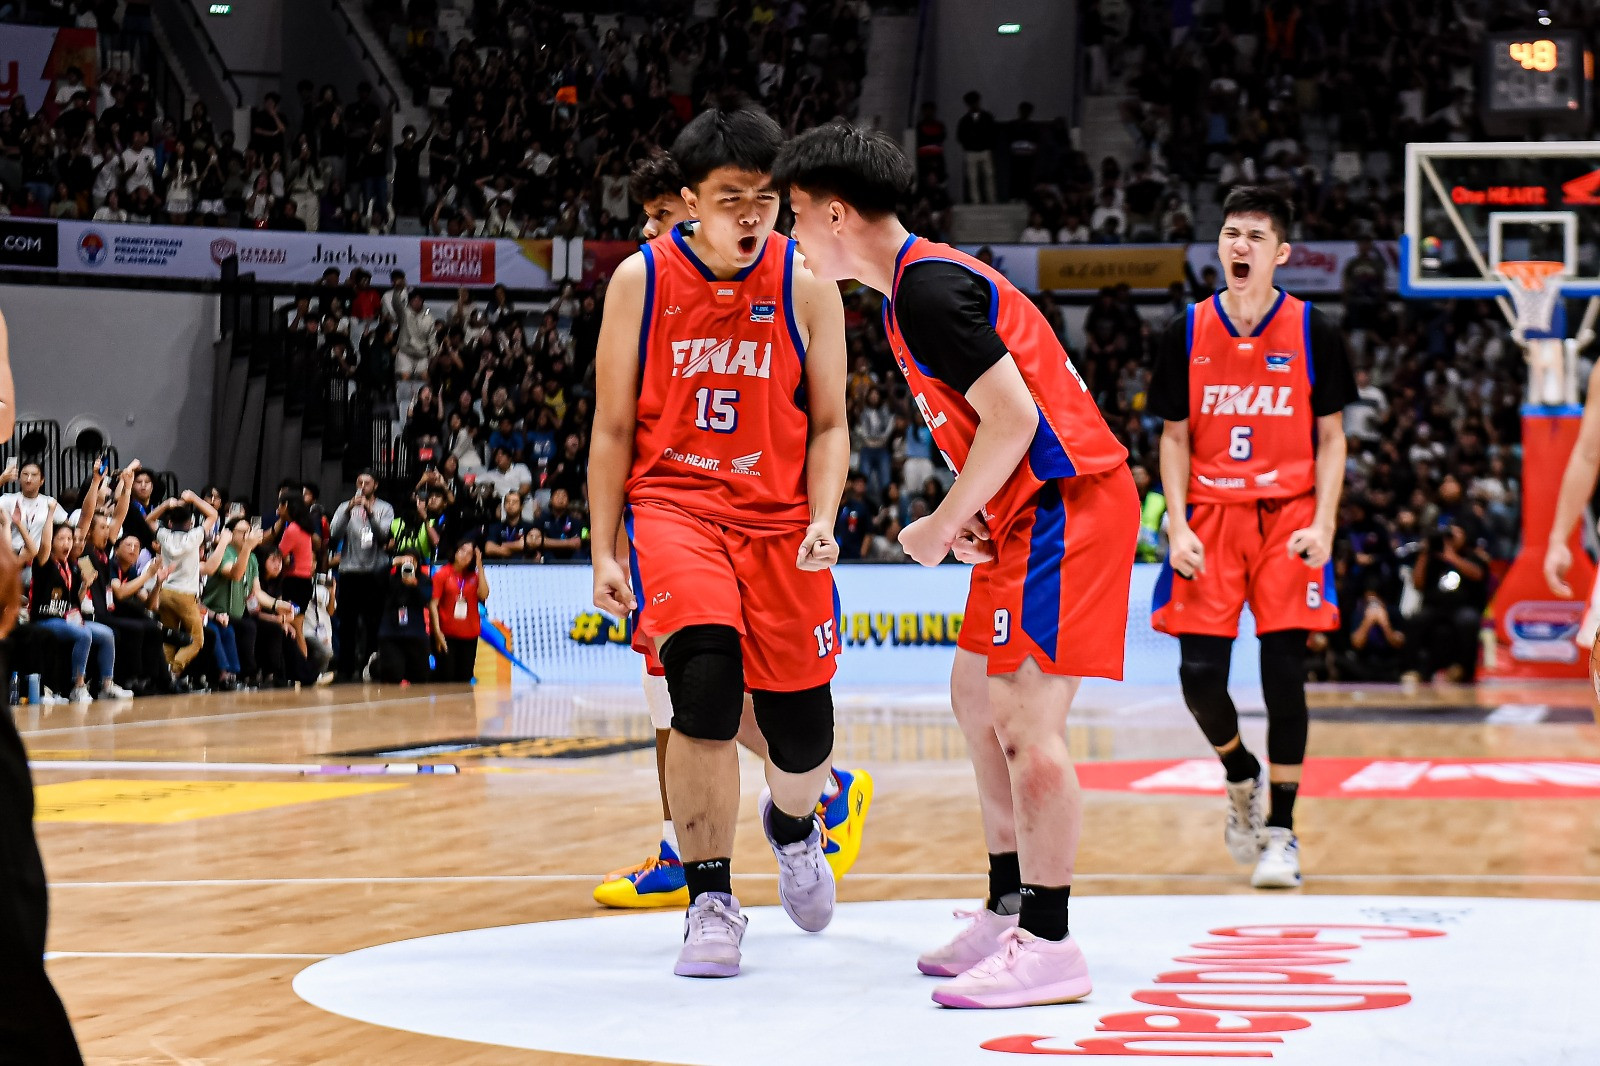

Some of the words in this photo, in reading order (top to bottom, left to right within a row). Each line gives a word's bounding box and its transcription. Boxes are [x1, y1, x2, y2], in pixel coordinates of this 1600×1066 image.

[1509, 39, 1557, 72] 48
[312, 243, 398, 266] Jackson
[432, 243, 462, 260] HOT
[432, 260, 483, 278] CREAM
[695, 387, 741, 434] 15
[1201, 382, 1294, 416] FINAL
[663, 447, 684, 462] One
[1228, 425, 1253, 461] 6
[730, 468, 761, 476] HONDA
[1306, 582, 1322, 608] 6
[813, 619, 837, 658] 15
[992, 609, 1012, 646] 9
